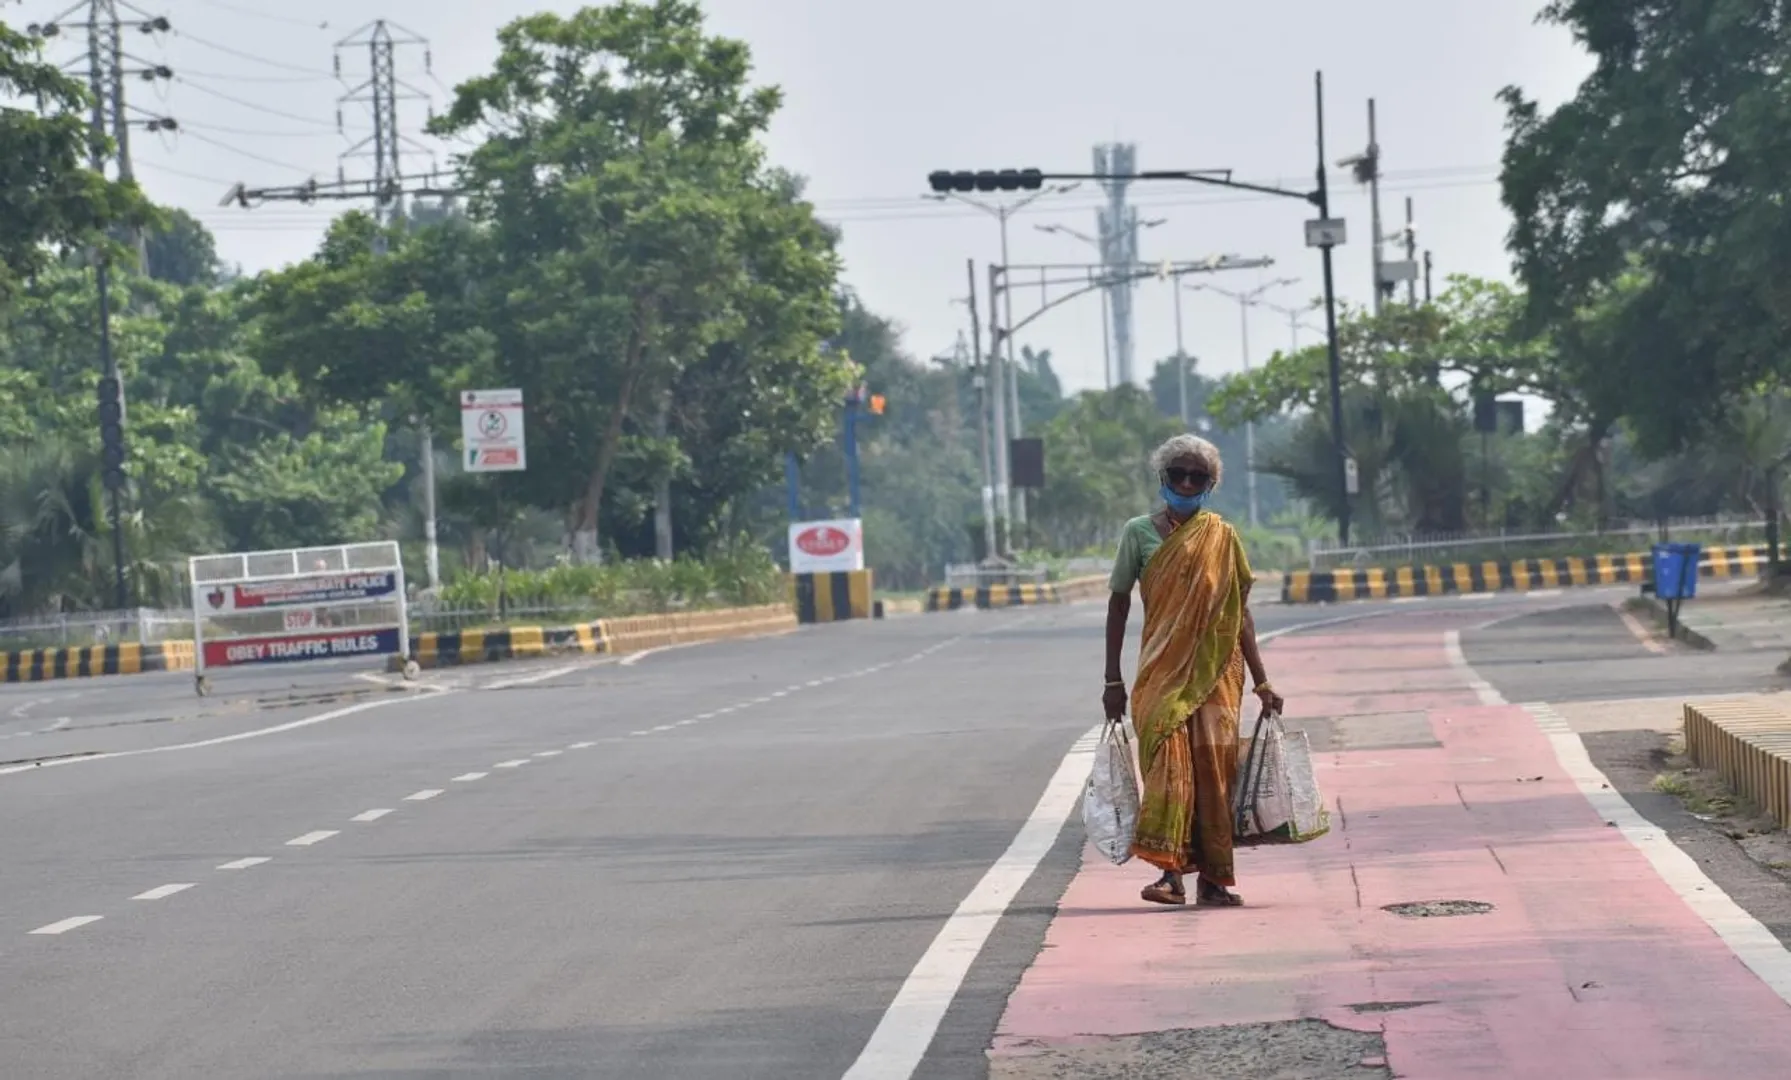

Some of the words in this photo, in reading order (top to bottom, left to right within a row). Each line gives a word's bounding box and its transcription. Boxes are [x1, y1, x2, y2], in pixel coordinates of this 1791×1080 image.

[348, 576, 388, 590] POLICE
[287, 610, 313, 628] STOP
[226, 645, 265, 661] OBEY
[269, 640, 328, 657] TRAFFIC
[331, 635, 378, 652] RULES
